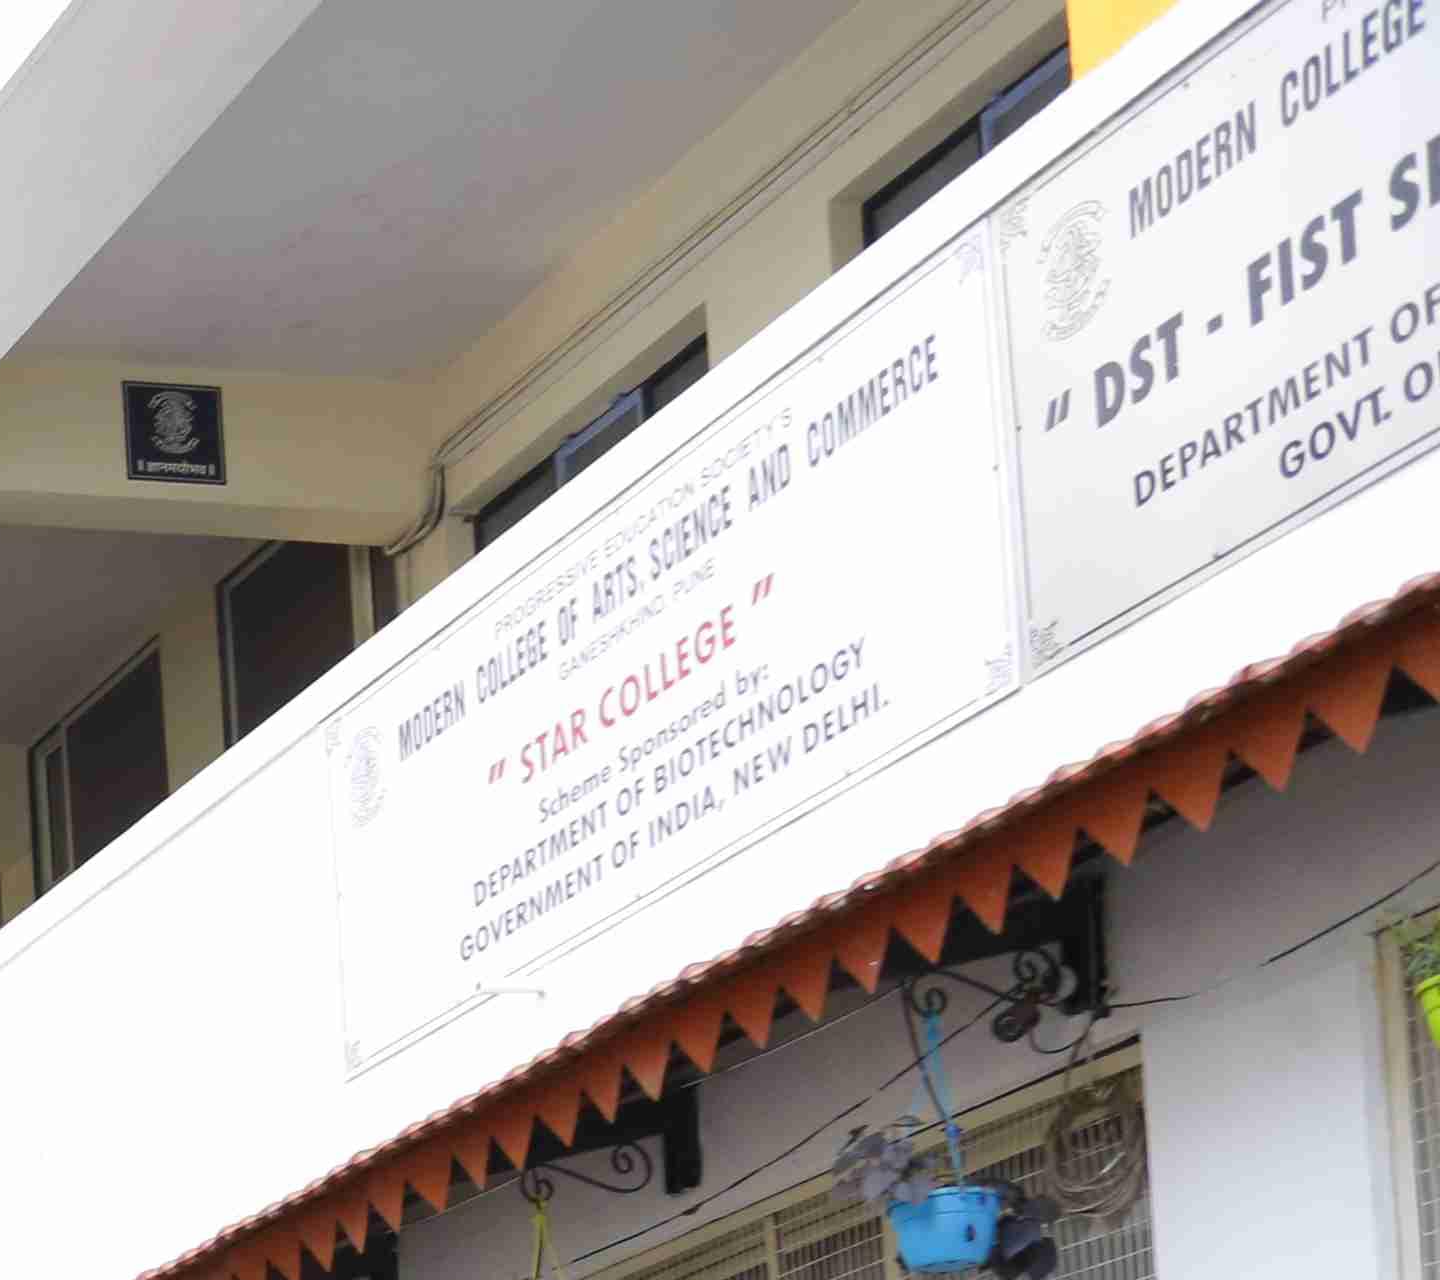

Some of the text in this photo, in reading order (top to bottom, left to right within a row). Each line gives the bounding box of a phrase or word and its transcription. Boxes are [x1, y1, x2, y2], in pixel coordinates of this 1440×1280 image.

[1128, 100, 1257, 240] MODERN
[1280, 0, 1425, 128] COLLEGE
[1094, 311, 1184, 429] DST
[1247, 188, 1362, 327] FIST
[1133, 326, 1373, 508] DEPARTMENT
[399, 680, 467, 762] MODERN
[476, 621, 548, 705] COLLEGE
[558, 598, 581, 646] OF
[650, 486, 733, 581] SCIENCE
[748, 443, 791, 511] AND
[807, 333, 939, 468] COMMERCE
[474, 634, 866, 907] DEPARTMENT OF BIOTECHNOLOGY
[521, 604, 736, 785] STAR COLLEGE
[538, 763, 611, 823] Scheme
[618, 691, 726, 774] Sponsored
[460, 855, 603, 961] GOVERNMENT
[611, 832, 640, 869] OF
[734, 736, 792, 796] NEW
